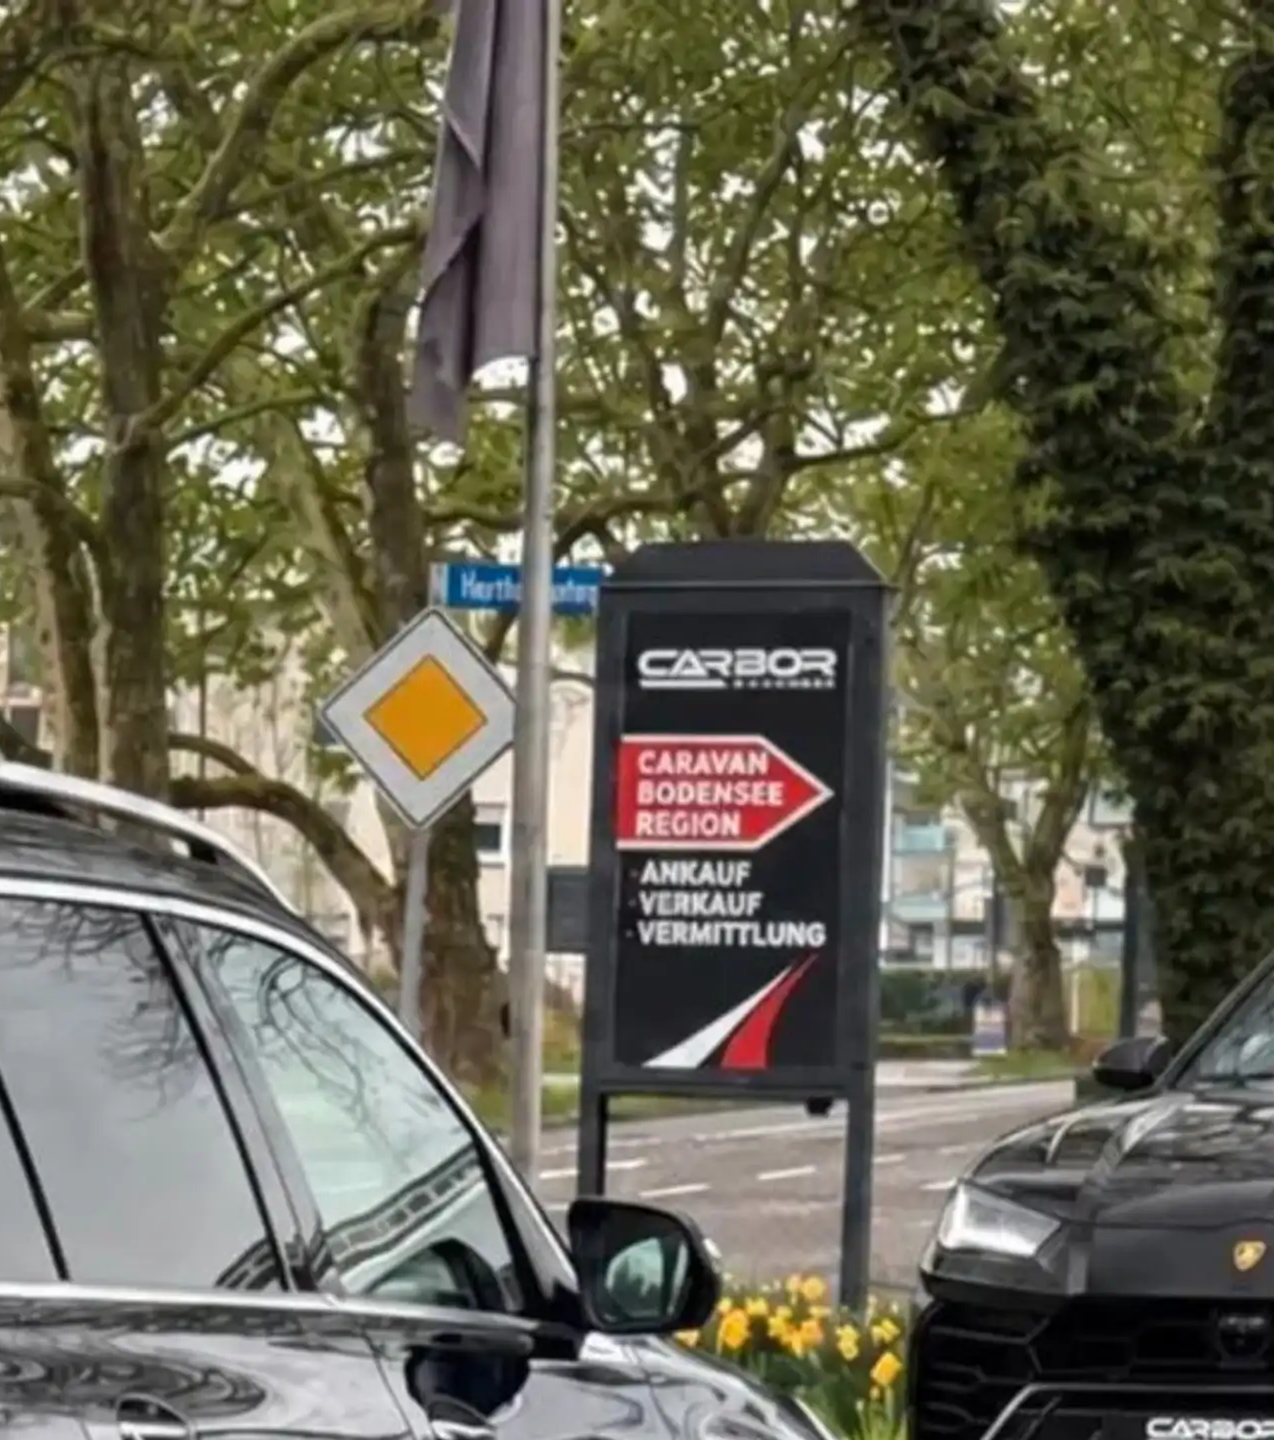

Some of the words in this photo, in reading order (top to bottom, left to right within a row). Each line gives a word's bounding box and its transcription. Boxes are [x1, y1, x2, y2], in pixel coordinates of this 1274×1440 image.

[638, 648, 837, 677] CARBOR
[637, 750, 769, 775] CARAVAN
[636, 780, 784, 806] BODENSEE
[635, 810, 741, 837] REGION
[640, 860, 752, 887] ANKAUF
[638, 890, 764, 917] VERKAUF
[636, 920, 827, 948] VERMITTLUNG
